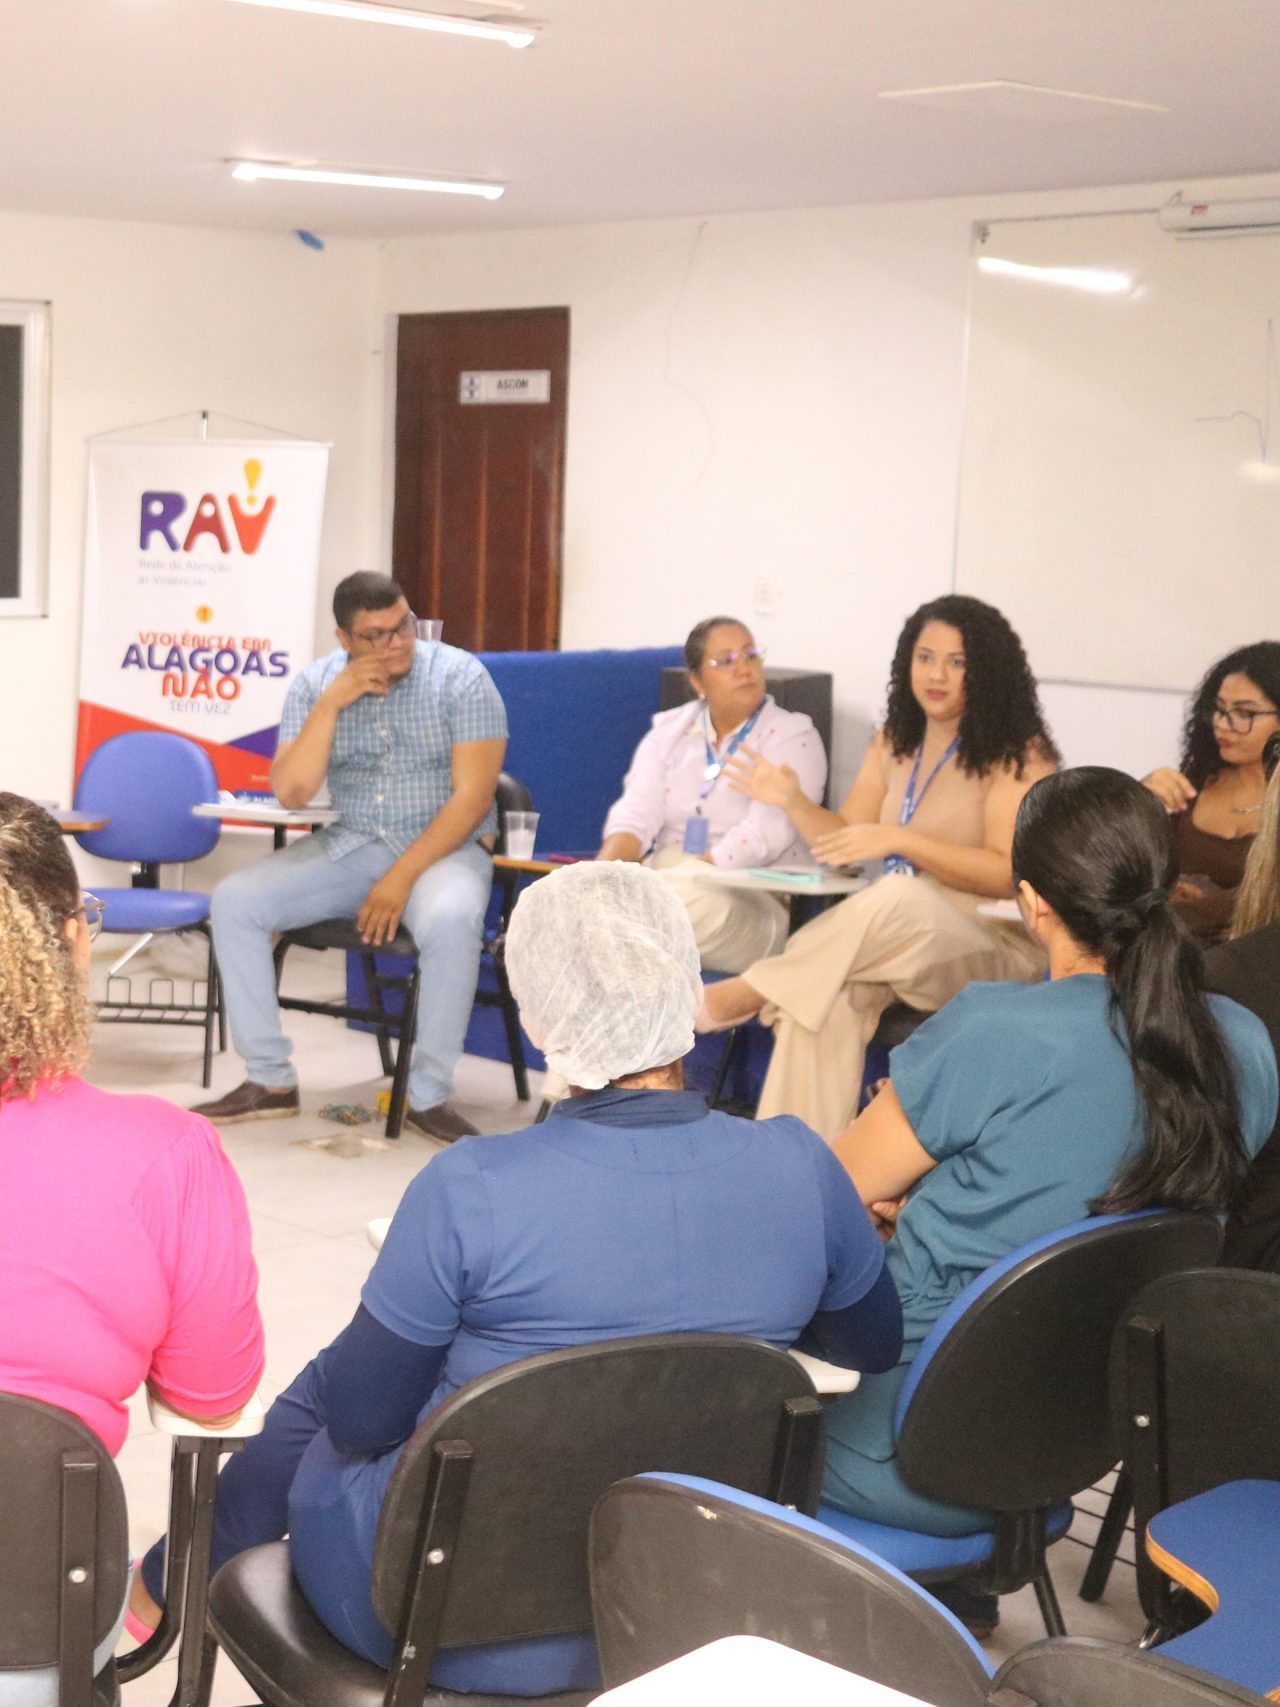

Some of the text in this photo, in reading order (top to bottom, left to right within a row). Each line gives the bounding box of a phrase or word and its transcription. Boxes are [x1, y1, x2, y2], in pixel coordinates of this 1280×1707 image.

[497, 378, 529, 390] ASCOM
[138, 558, 232, 574] Rede de Atenção
[152, 574, 207, 587] Violências
[138, 629, 237, 652] VIOLÊNCIA
[121, 642, 291, 680] ALAGOAS
[161, 667, 242, 701] NÃO
[170, 700, 232, 715] TEM VEZ
